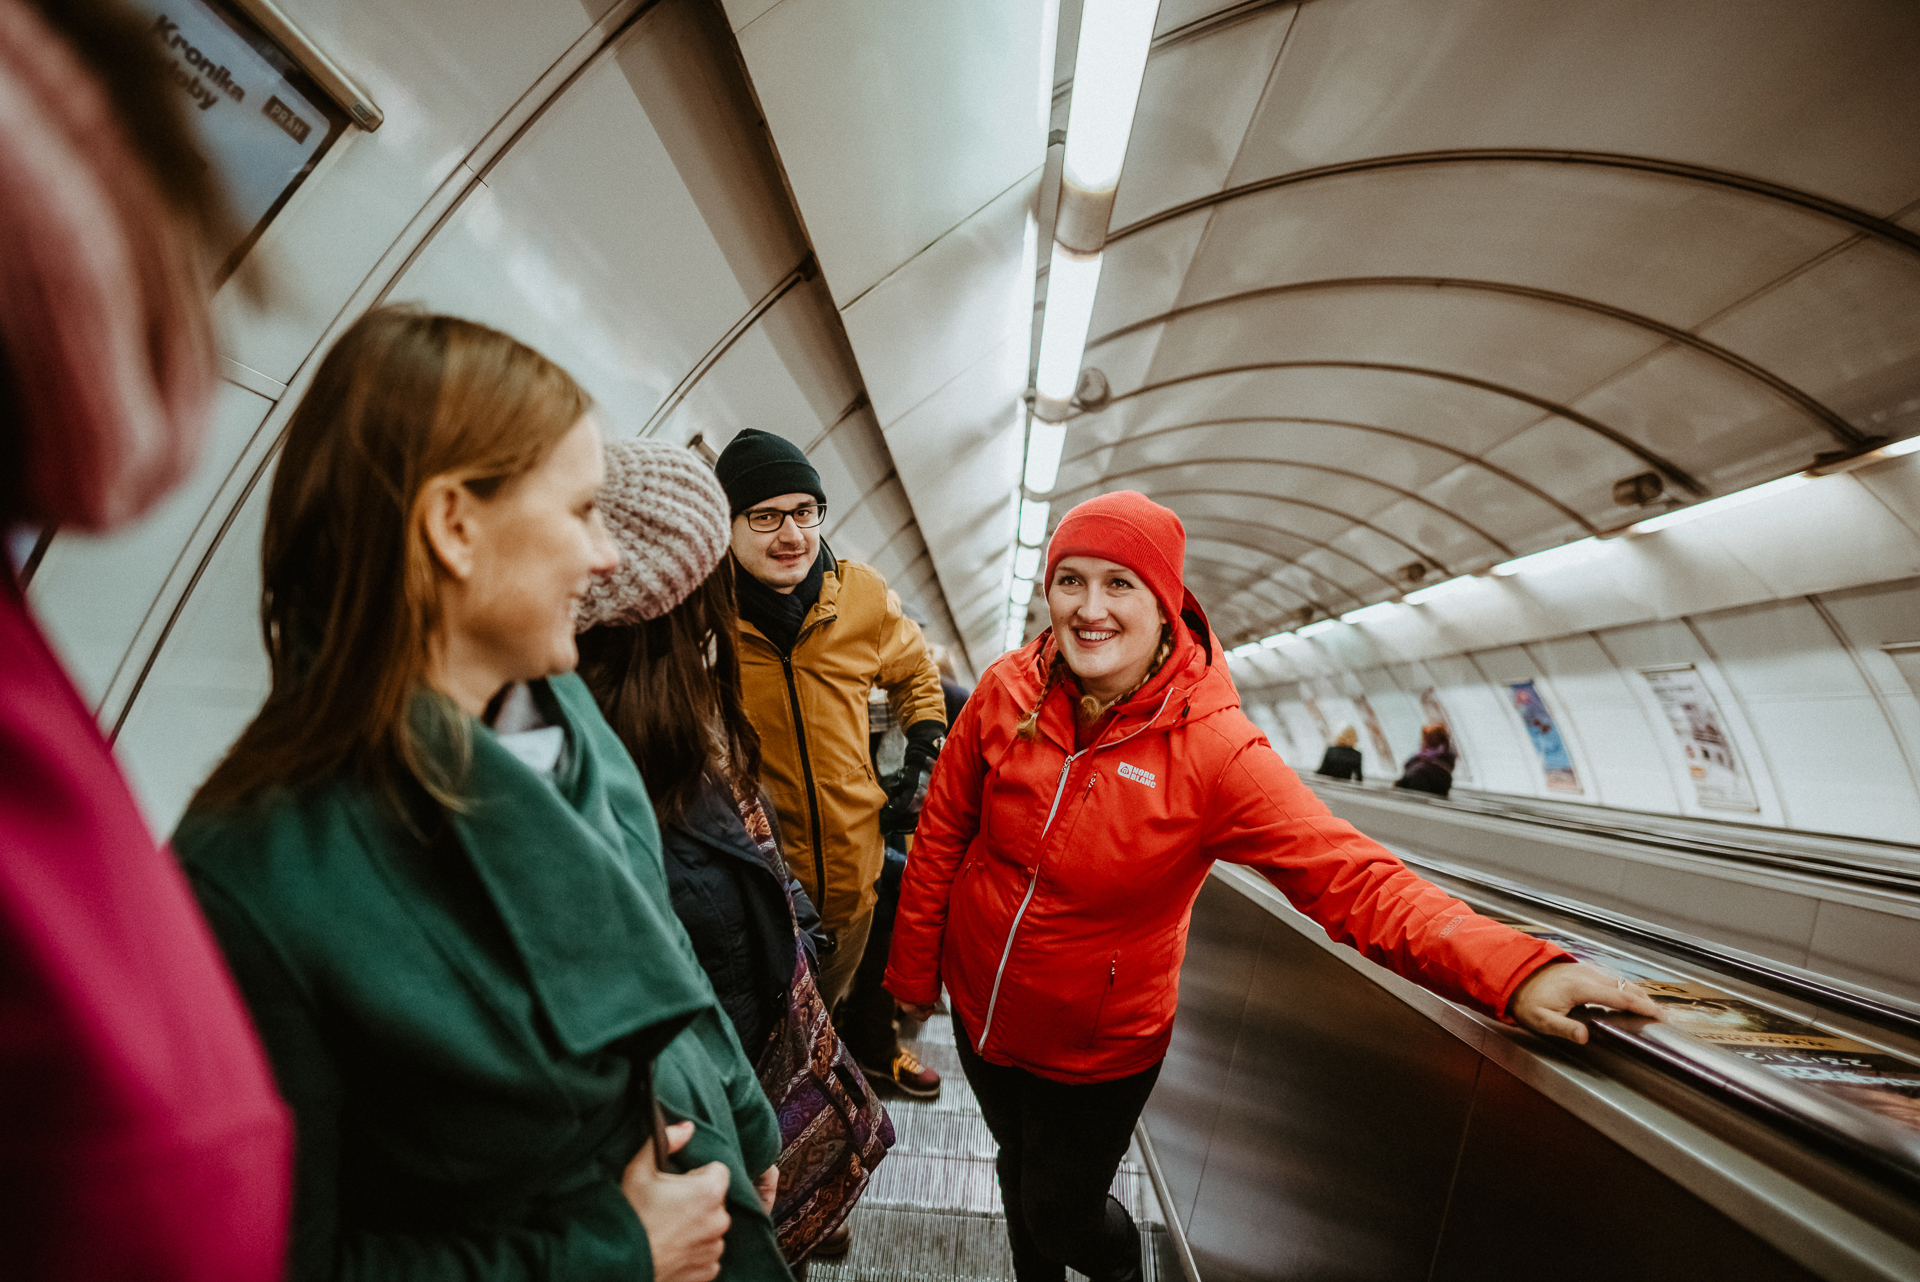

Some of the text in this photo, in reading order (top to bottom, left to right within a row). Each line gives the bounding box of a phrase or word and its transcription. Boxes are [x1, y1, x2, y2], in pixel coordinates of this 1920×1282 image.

[155, 14, 245, 103] Kronika
[1130, 773, 1156, 789] BLANC
[1132, 766, 1156, 781] NORD
